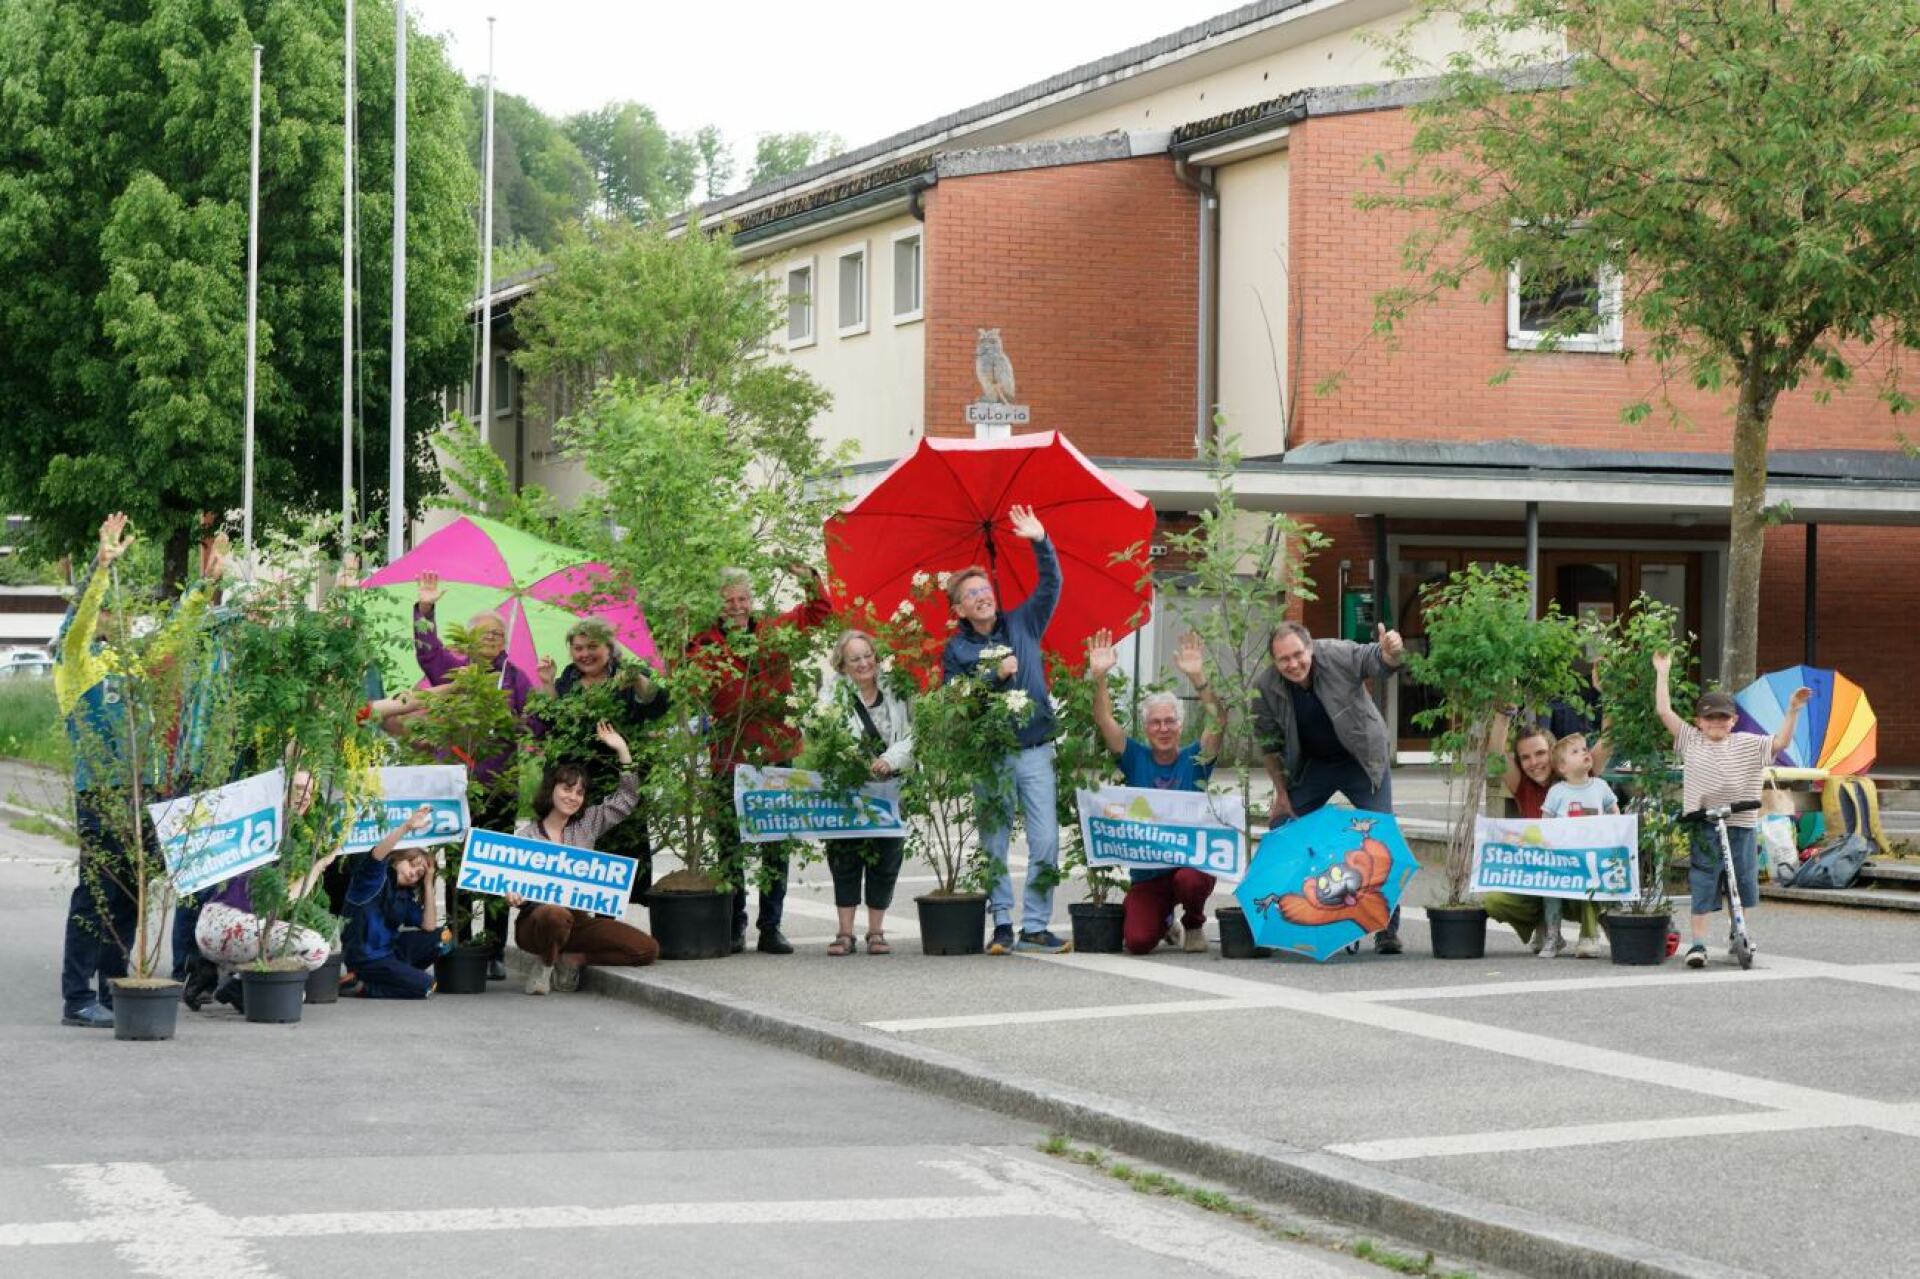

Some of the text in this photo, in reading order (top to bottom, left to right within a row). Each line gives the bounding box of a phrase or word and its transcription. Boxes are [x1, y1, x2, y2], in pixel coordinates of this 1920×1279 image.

[968, 407, 1027, 421] Euloria
[1092, 820, 1188, 847] Stadtklima
[473, 839, 628, 886] umverkehR
[1095, 840, 1187, 865] Initiativen
[1188, 830, 1234, 871] Ja
[1484, 846, 1581, 868] Stadtklima
[461, 867, 623, 916] Zukunft inkl.
[1482, 867, 1584, 890] Initiativen
